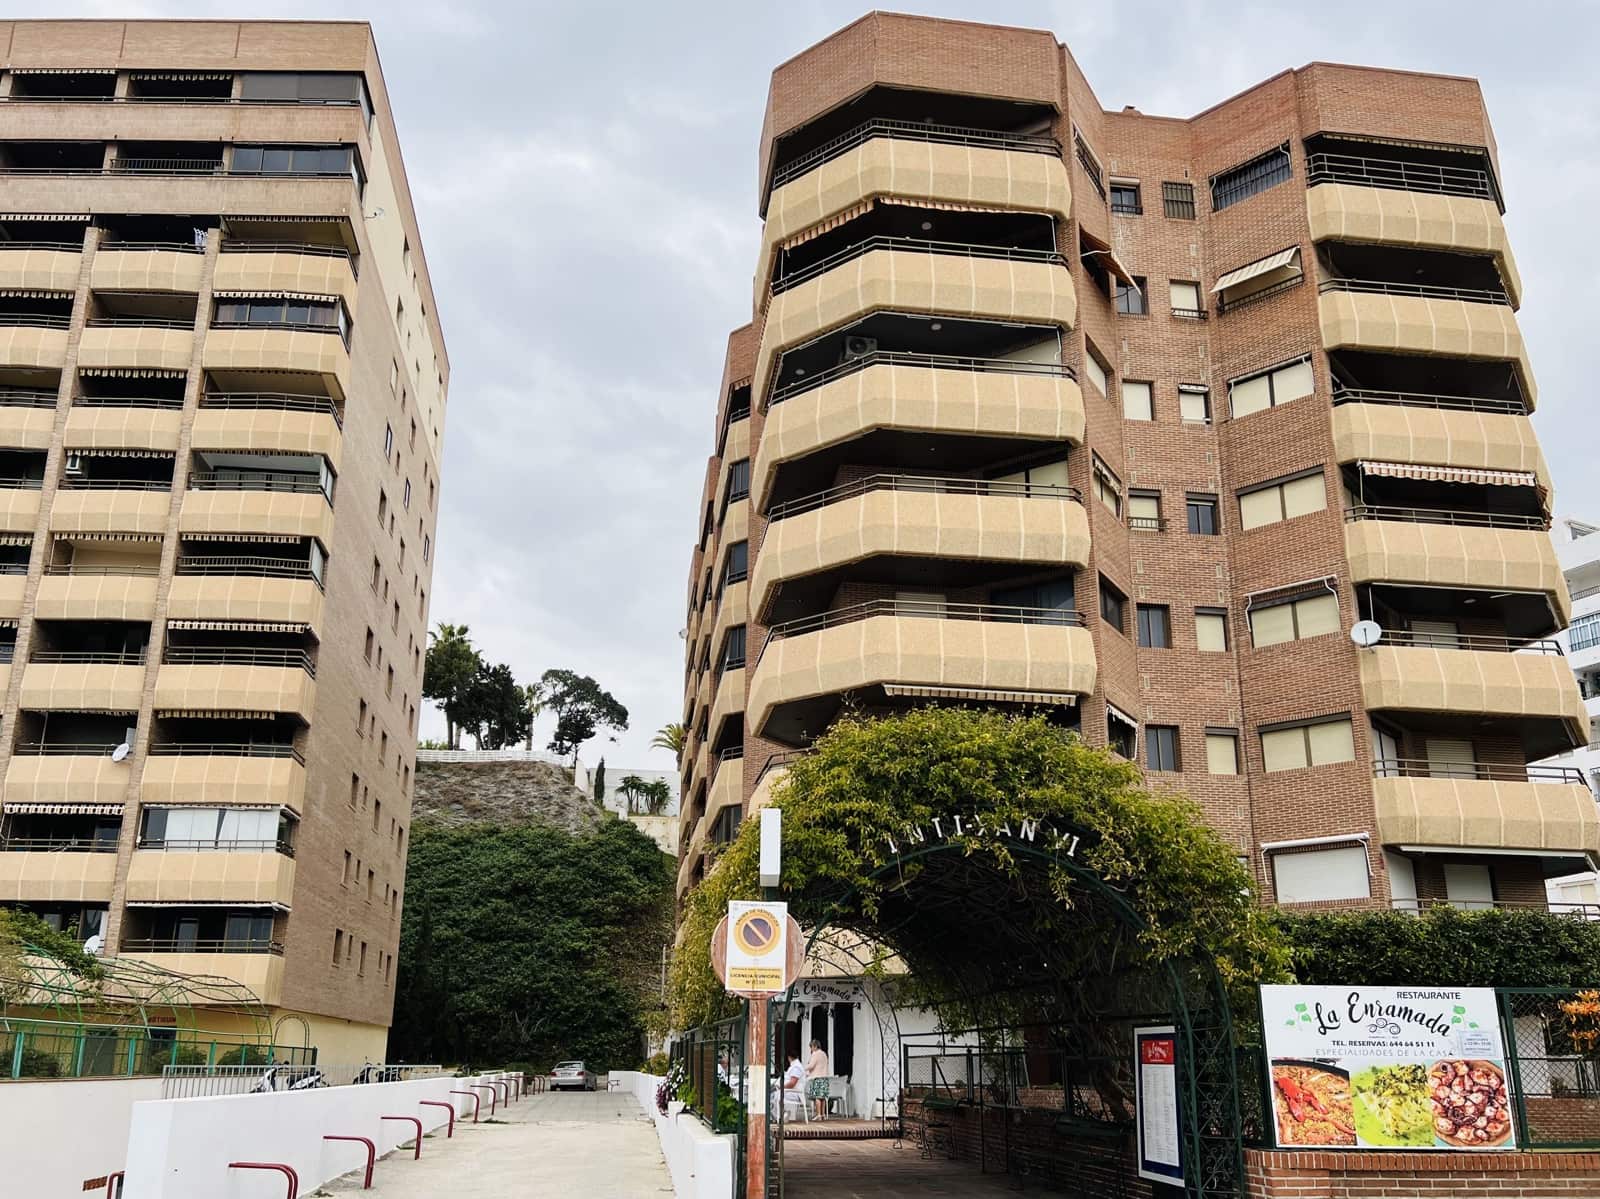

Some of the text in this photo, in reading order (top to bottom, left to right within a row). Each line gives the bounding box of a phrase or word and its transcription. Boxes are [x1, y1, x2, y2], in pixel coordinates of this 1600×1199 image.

[1396, 991, 1461, 1000] RESTAURANTE
[1315, 991, 1450, 1037] La Enramada
[1316, 1048, 1393, 1057] ESPECIALIDADES
[1397, 1049, 1409, 1057] DE
[1414, 1049, 1426, 1057] LA
